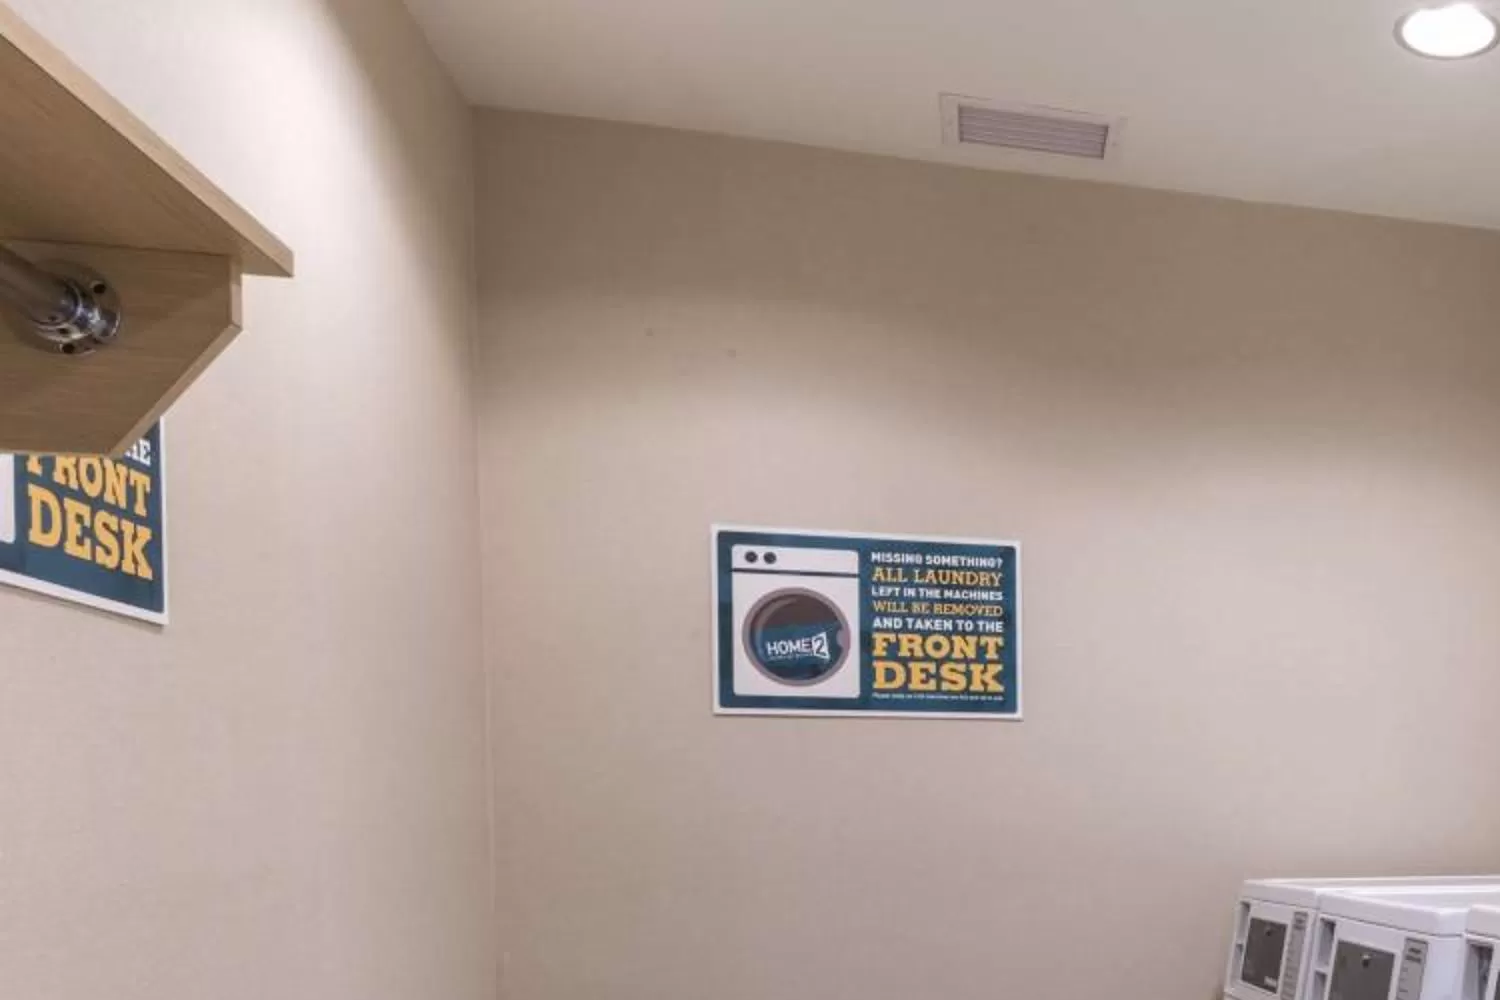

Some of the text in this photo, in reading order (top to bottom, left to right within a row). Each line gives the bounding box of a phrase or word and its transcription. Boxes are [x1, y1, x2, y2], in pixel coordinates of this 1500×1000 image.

[27, 482, 153, 581] DESK
[871, 552, 1004, 569] MISSING SOMETHING?
[872, 567, 1003, 587] ALL LAUNDRY
[871, 586, 1003, 601] LEFT IN THE MACHINES
[873, 601, 1004, 617] WILL BE REMOVED
[873, 617, 1004, 633] AND TAKEN TO THE
[872, 632, 1005, 660] FRONT
[872, 661, 1005, 693] DESK
